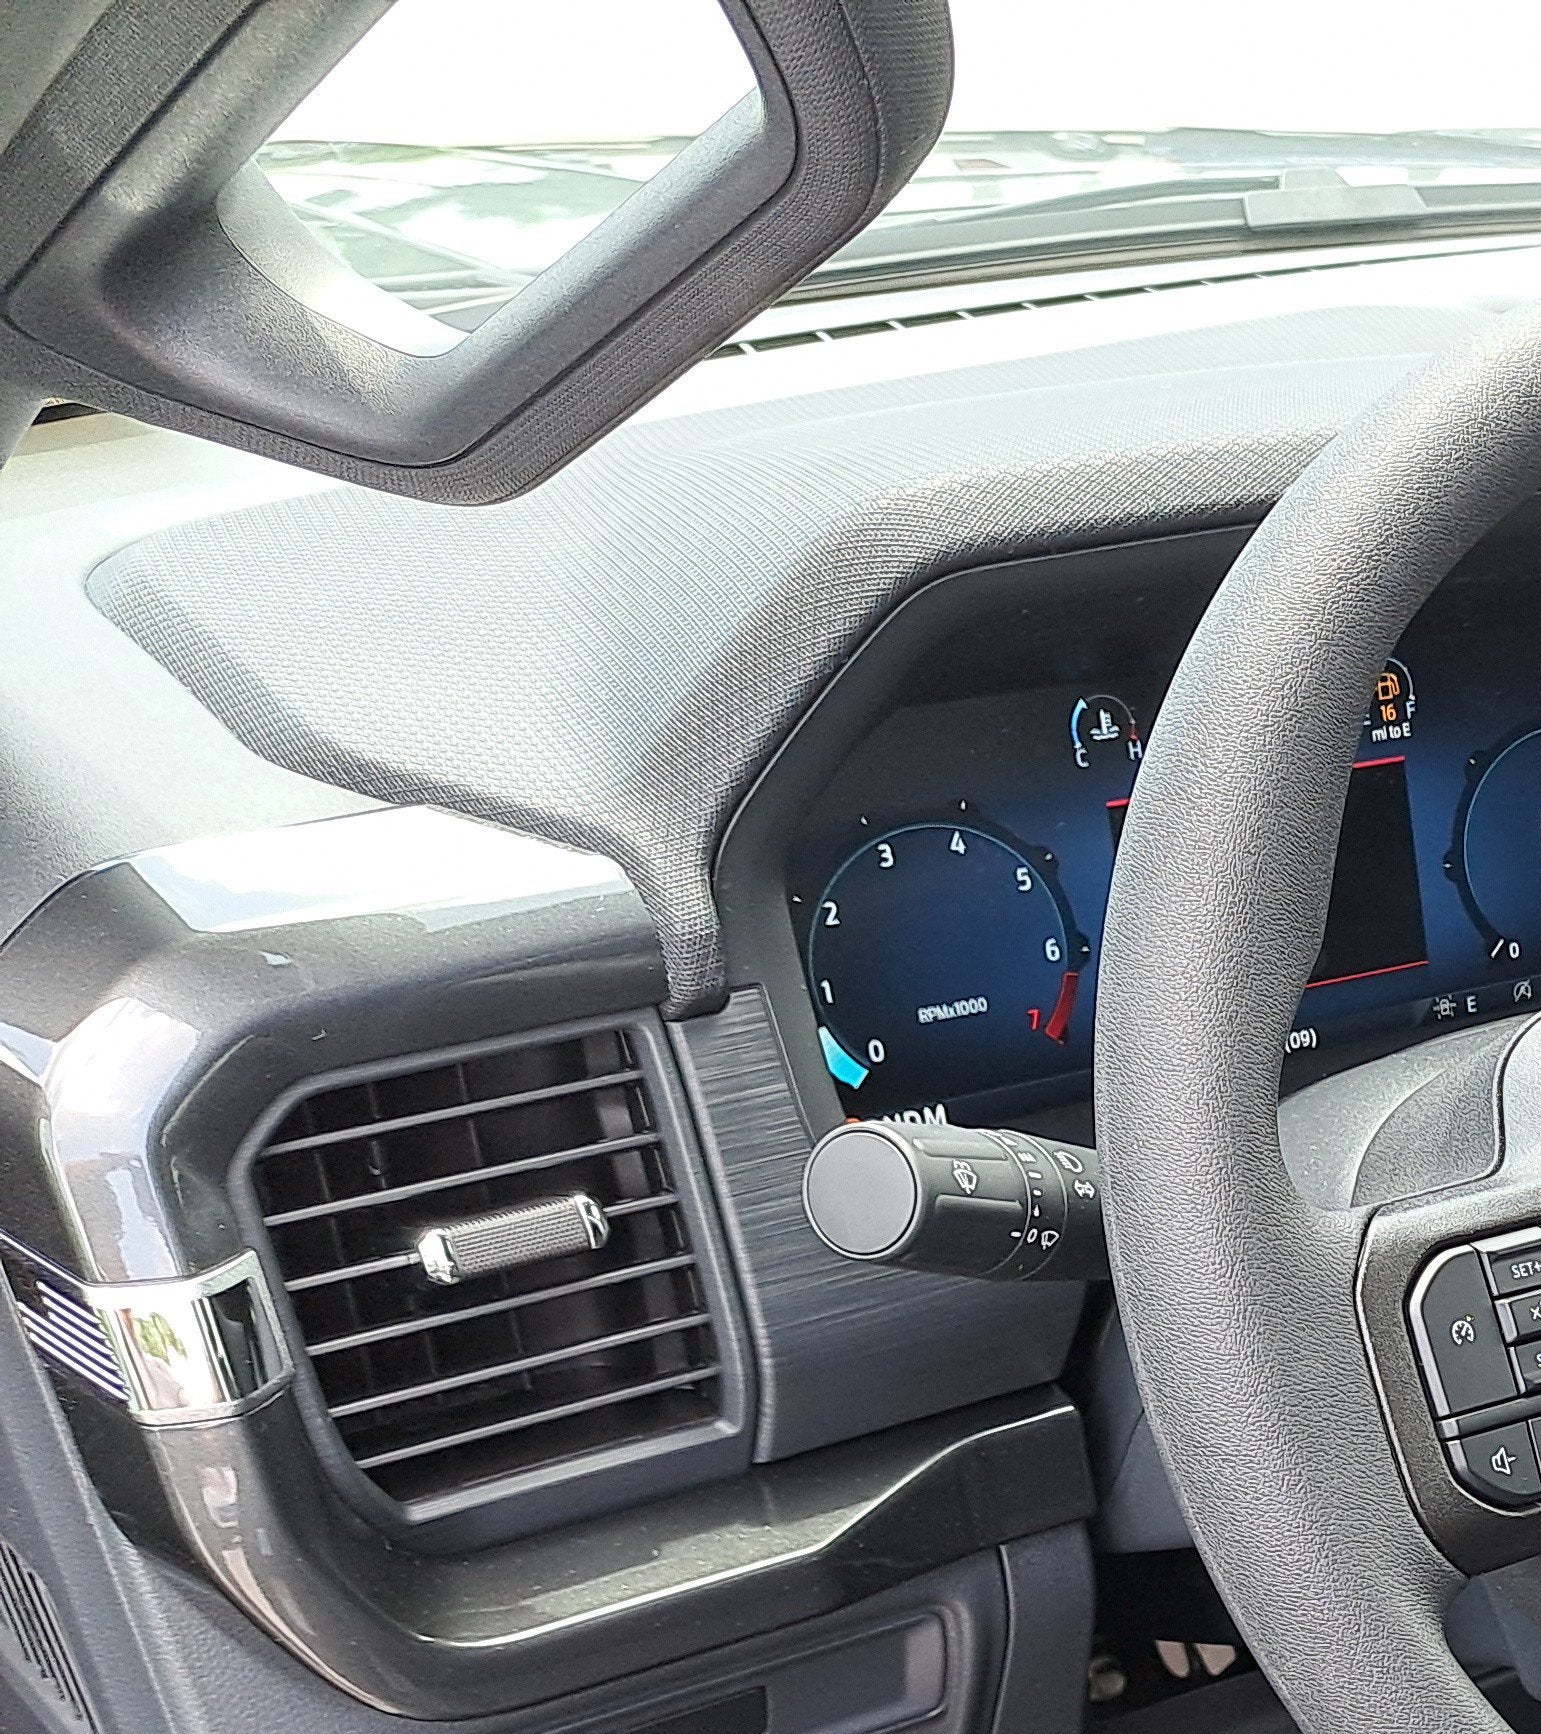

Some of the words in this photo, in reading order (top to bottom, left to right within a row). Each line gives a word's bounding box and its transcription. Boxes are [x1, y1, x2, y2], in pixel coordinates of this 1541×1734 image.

[1380, 703, 1397, 722] 16
[1405, 700, 1416, 720] F
[1388, 725, 1402, 739] to
[1402, 721, 1412, 737] E
[1074, 748, 1090, 768] C
[1127, 739, 1143, 761] H
[948, 830, 966, 855] 4
[877, 843, 894, 869] 3
[1015, 867, 1033, 892] 5
[822, 901, 841, 926] 2
[1044, 937, 1060, 962] 6
[1509, 942, 1520, 959] 0
[819, 979, 834, 1004] 1
[917, 996, 989, 1024] RPMx1000
[1467, 995, 1478, 1013] E
[1027, 1009, 1041, 1031] 7
[868, 1039, 886, 1063] 0
